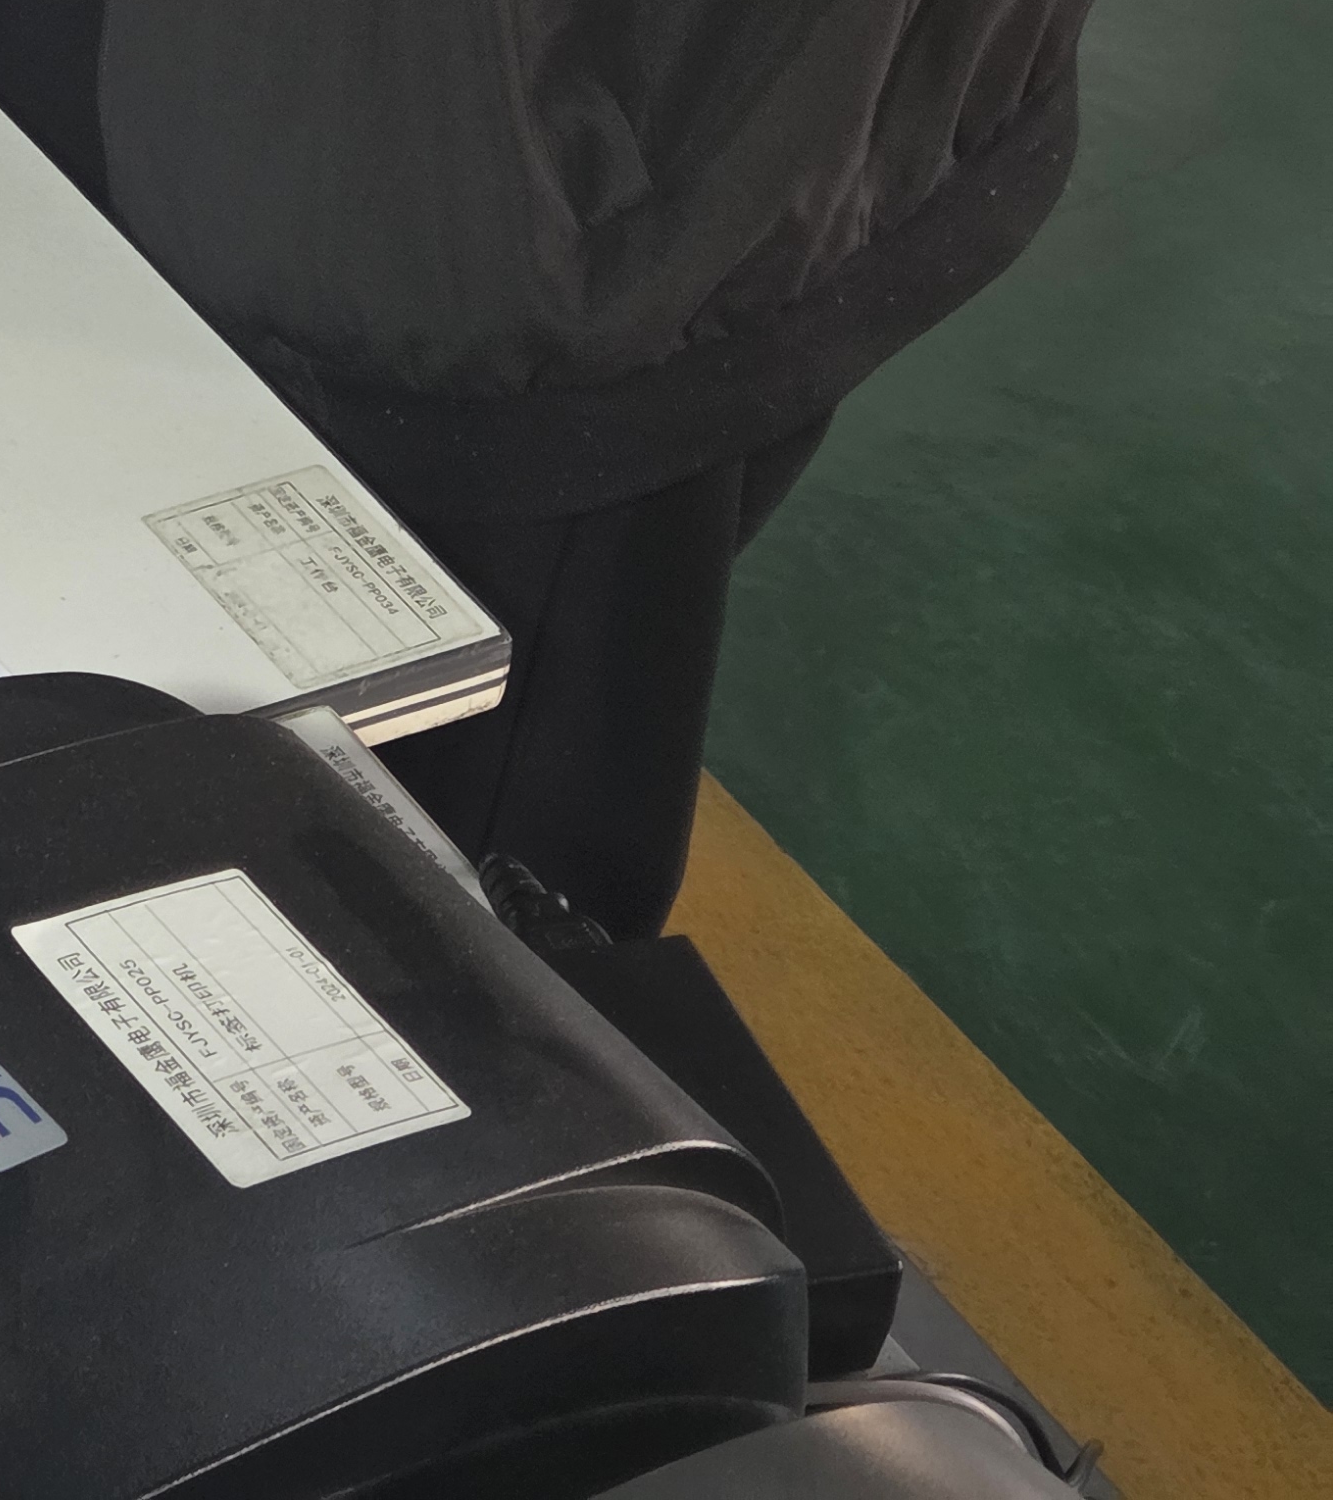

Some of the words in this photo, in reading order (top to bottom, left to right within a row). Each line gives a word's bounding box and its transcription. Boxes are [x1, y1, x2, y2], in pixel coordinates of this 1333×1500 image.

[313, 493, 451, 619] 深圳市福金鹰电子有限公司
[324, 545, 402, 616] FJYSC-PP034
[116, 957, 219, 1058] FJYSC-PP025
[167, 961, 264, 1053] 标签打印机
[283, 943, 349, 1002] 2024-01-01
[51, 950, 242, 1140] 深圳市福金鹰电子有限公司
[388, 1055, 426, 1083] 日期
[225, 1076, 308, 1153] 固定资产编号
[272, 1076, 332, 1128] 资产名称
[332, 1061, 394, 1114] 规格型号
